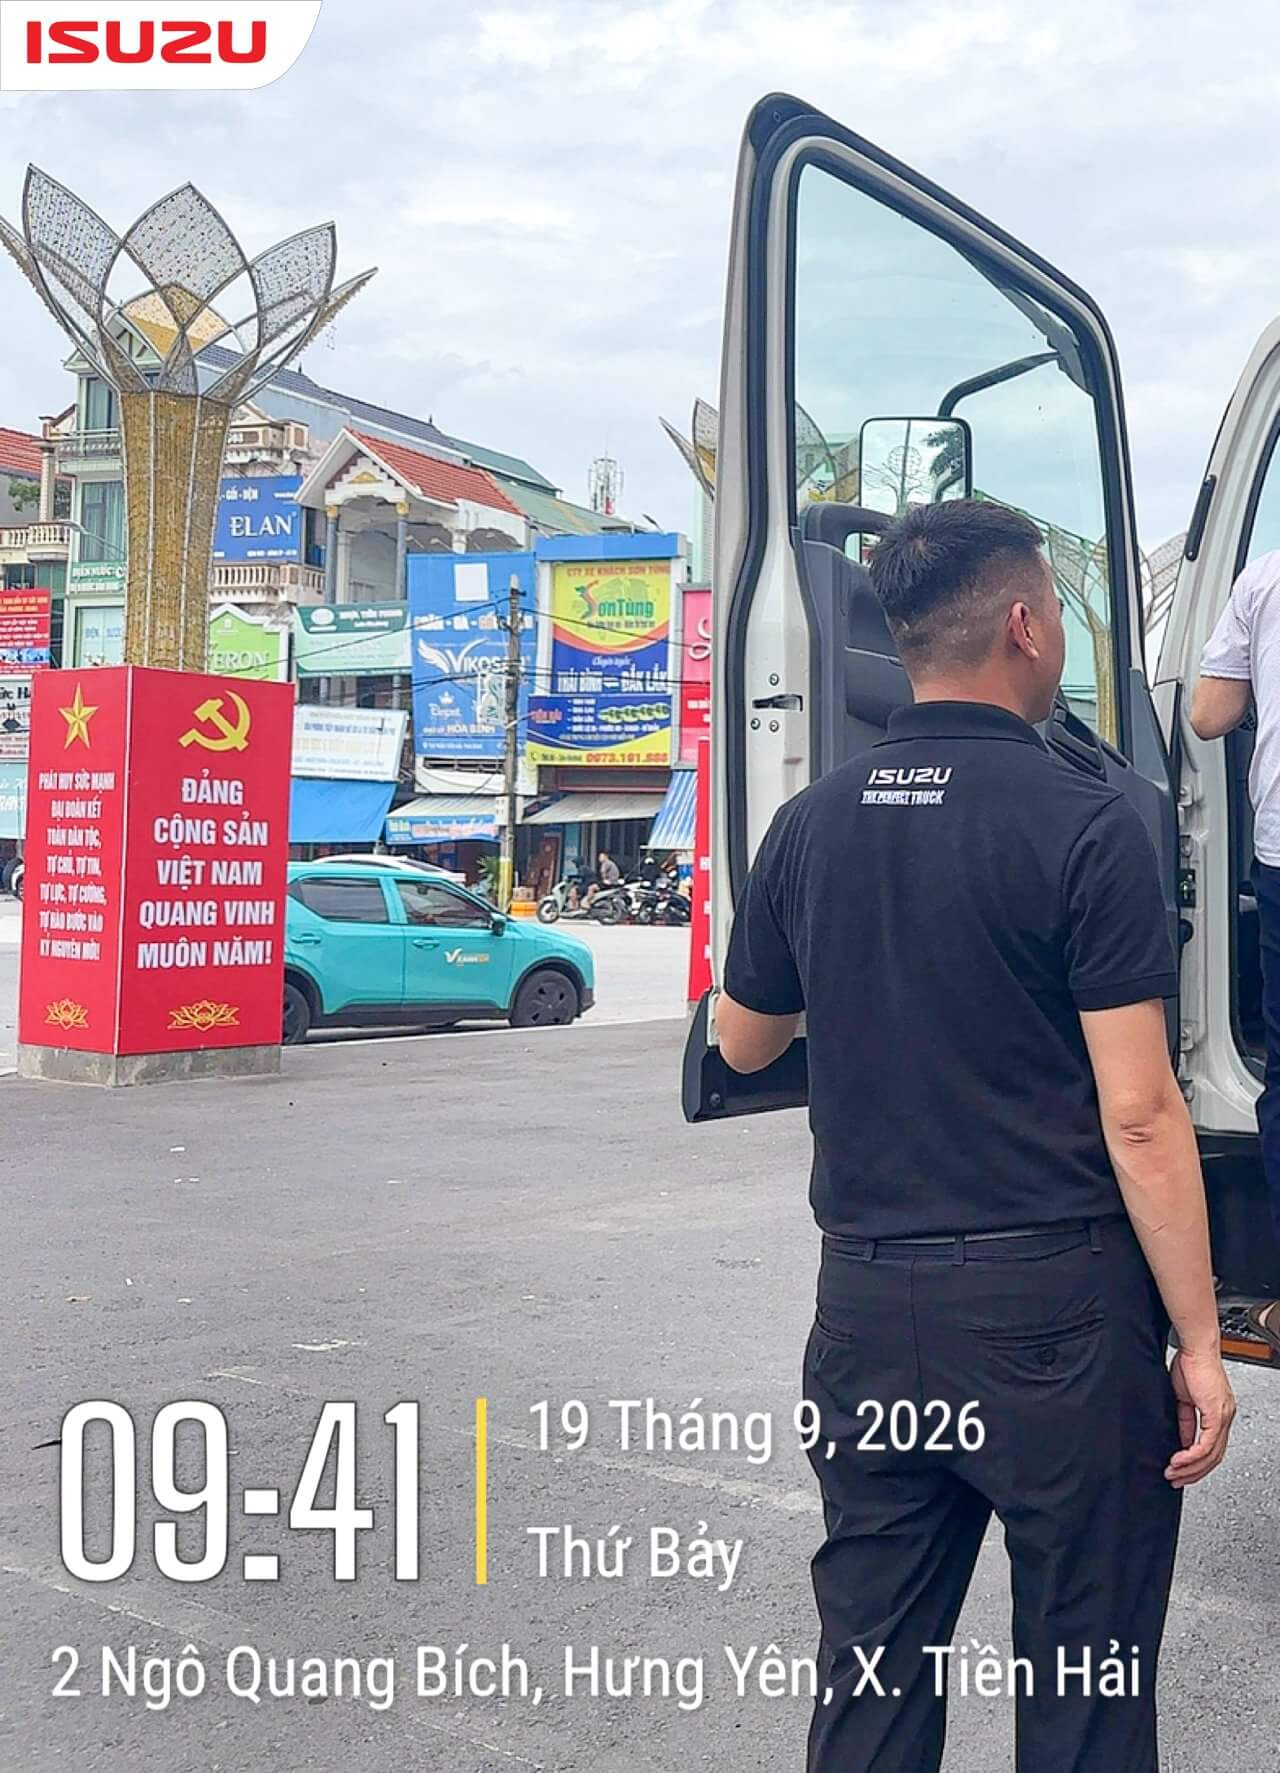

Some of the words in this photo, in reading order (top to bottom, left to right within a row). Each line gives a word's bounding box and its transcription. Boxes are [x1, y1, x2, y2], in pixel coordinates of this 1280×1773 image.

[181, 769, 243, 805] ĐẢNG
[867, 766, 952, 785] ISUZU
[911, 790, 945, 805] TRUCK
[153, 813, 217, 850] CỘNG
[223, 812, 268, 847] SẢN
[156, 855, 206, 891] VIỆT
[211, 861, 262, 886] NAM
[139, 901, 217, 928] QUANG
[223, 900, 275, 926] VINH
[137, 938, 209, 969] MUÔN
[212, 936, 272, 966] NĂM!
